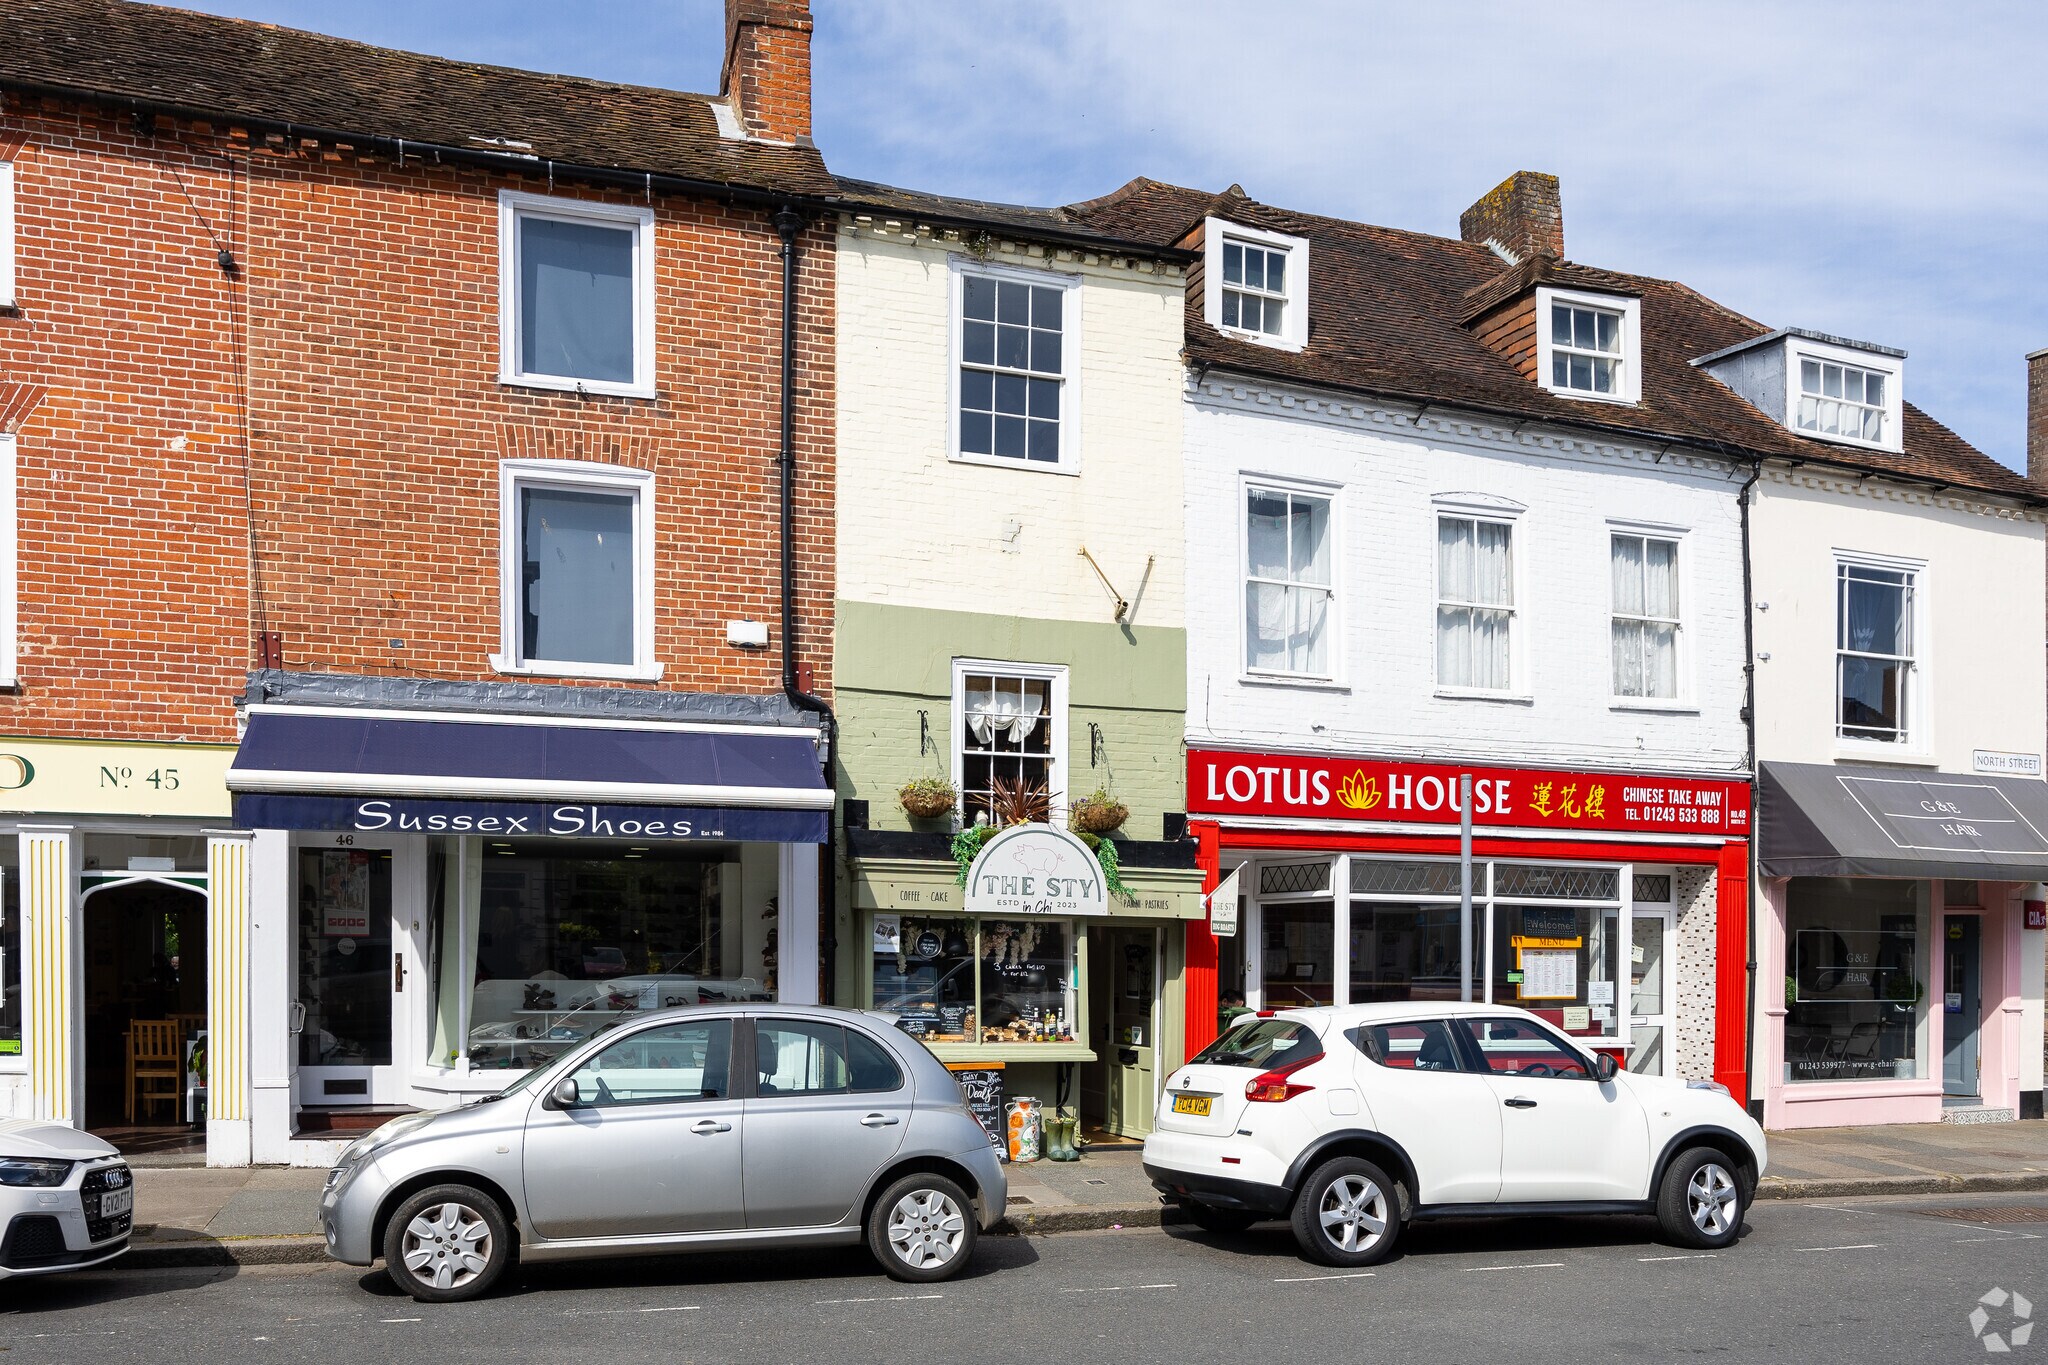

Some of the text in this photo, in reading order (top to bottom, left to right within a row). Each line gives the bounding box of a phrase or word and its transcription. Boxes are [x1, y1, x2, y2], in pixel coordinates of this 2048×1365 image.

[1976, 755, 2037, 769] NORTH STREET
[145, 768, 180, 790] 45
[1206, 764, 1331, 806] LOTUS
[1623, 787, 1722, 806] CHINESE TAKE AWAY
[354, 801, 528, 834] Sussex
[548, 806, 692, 836] Shoes
[1625, 806, 1720, 824] TEL. 01243 533 888
[1940, 824, 1982, 837] HAIR
[336, 835, 354, 845] 46
[983, 875, 1094, 898] THE STY
[900, 890, 948, 902] COFFEE CAKE
[1022, 899, 1053, 913] in Chi
[1056, 901, 1077, 909] 2023
[1145, 899, 1169, 910] PASTRIES
[1225, 902, 1236, 911] STY
[1530, 919, 1571, 930] Welcome
[1539, 937, 1565, 946] MENU
[993, 962, 1001, 971] 3
[1846, 972, 1869, 982] HAIR
[1799, 1062, 1820, 1070] 01243
[1821, 1061, 1846, 1070] 539977
[967, 1084, 991, 1103] Deals
